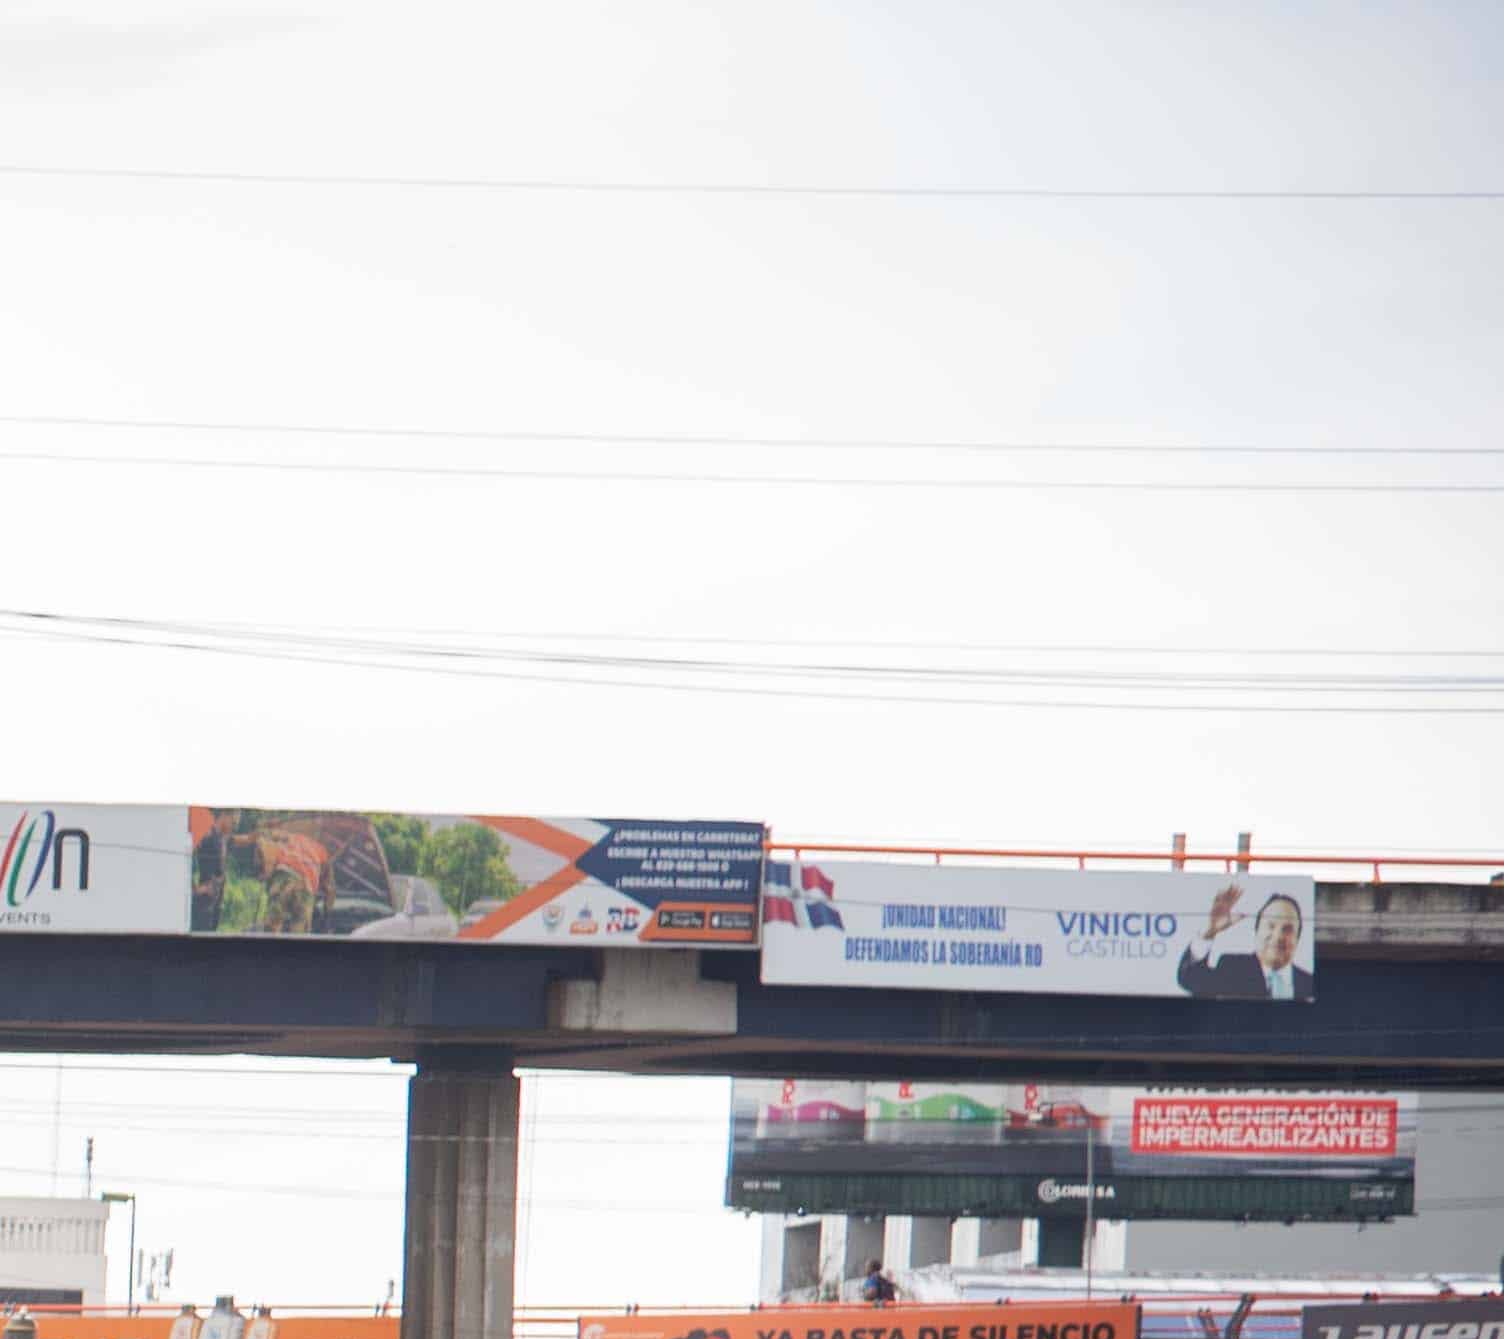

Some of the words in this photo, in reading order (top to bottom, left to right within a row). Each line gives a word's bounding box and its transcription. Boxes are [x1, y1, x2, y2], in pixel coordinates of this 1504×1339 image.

[938, 905, 1006, 931] NACIONAL!
[1056, 911, 1178, 938] VINICIO
[845, 937, 928, 964] DEFENDAMOS
[932, 940, 946, 964] LA
[950, 939, 1022, 966] SOBERANÍA
[1067, 939, 1167, 959] CASTILLO
[1140, 1104, 1211, 1126] NUEVA
[1216, 1101, 1359, 1127] GENERACIÓN
[1365, 1106, 1389, 1126] DE
[1139, 1126, 1389, 1149] IMPERMEABILIZANTES
